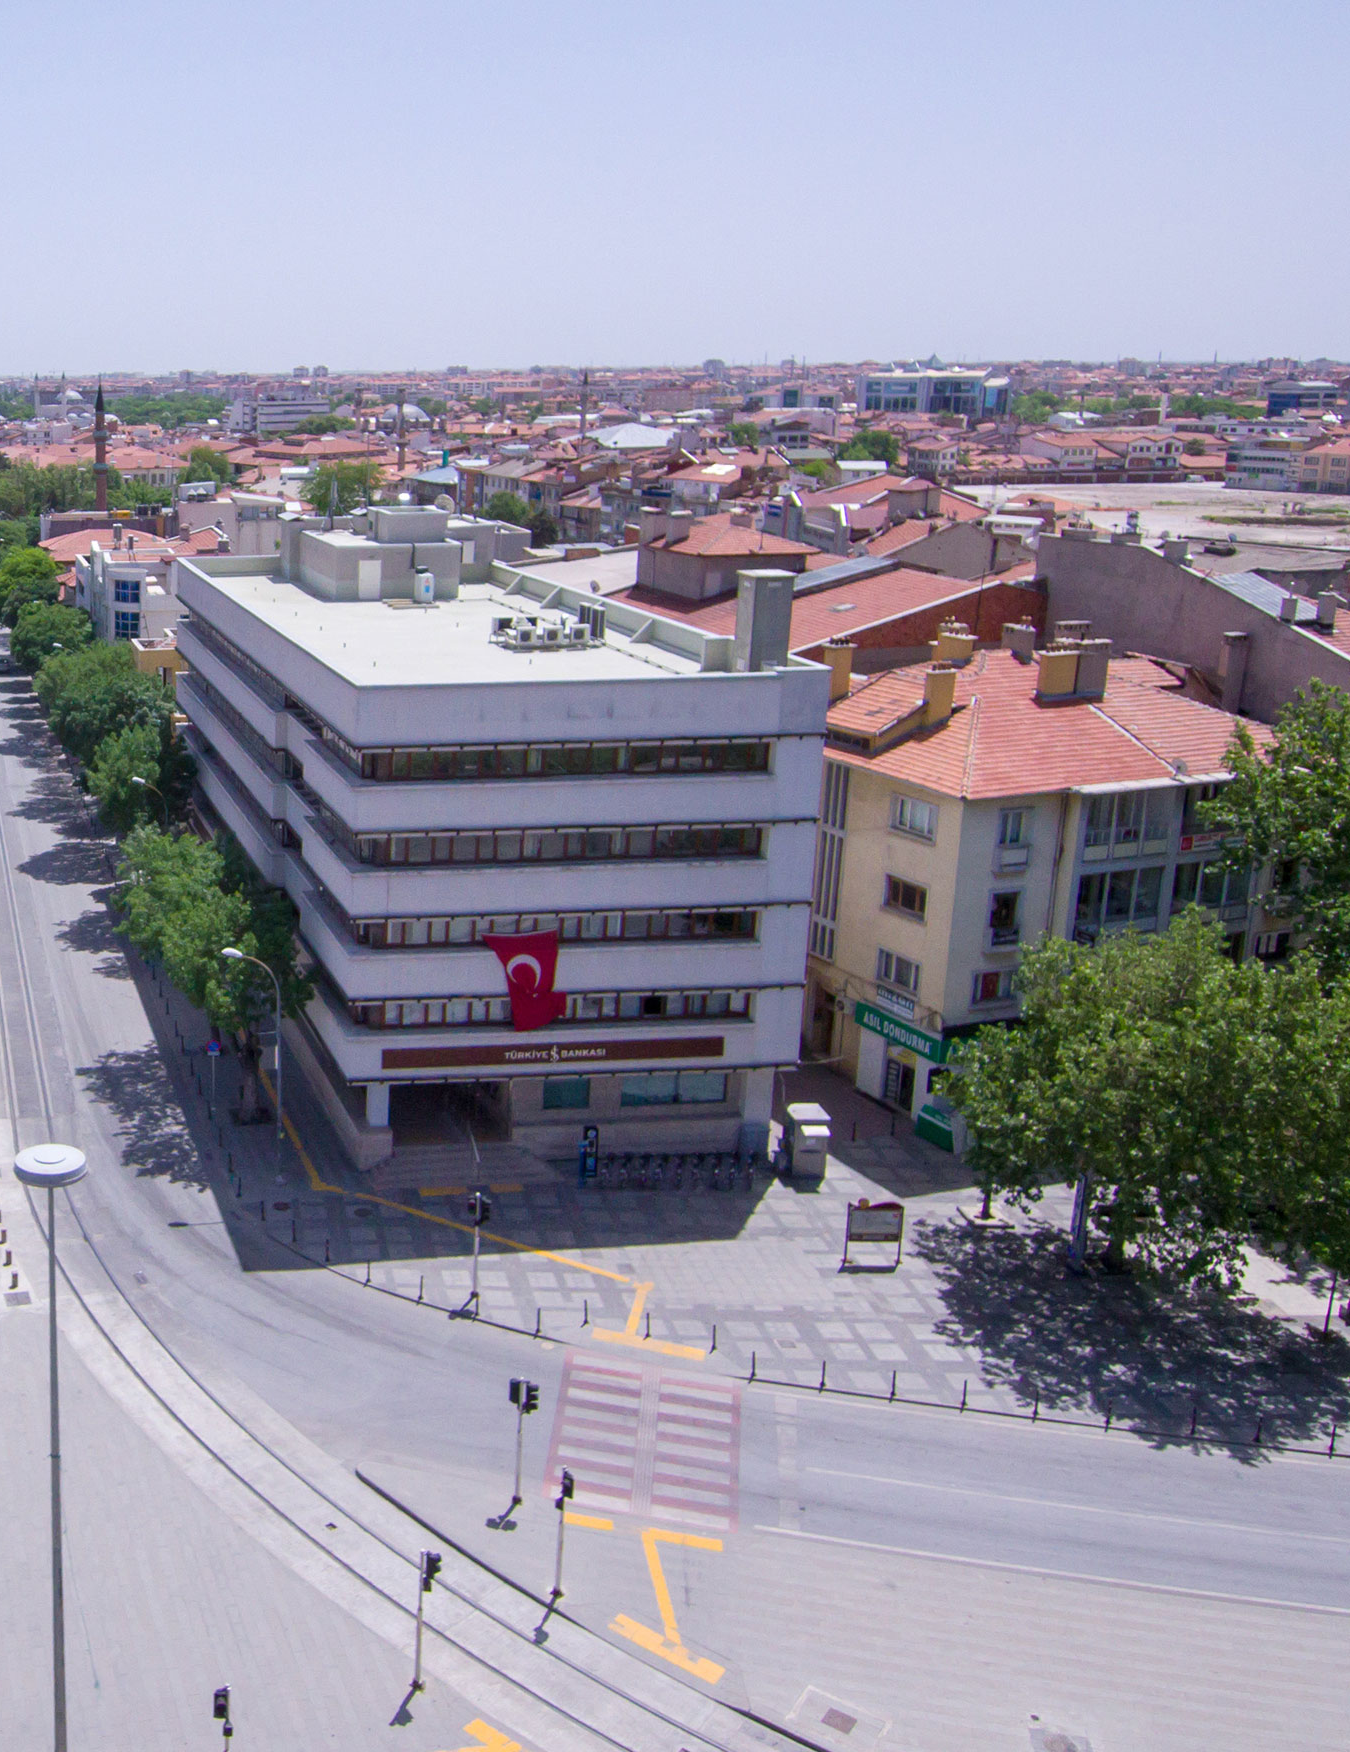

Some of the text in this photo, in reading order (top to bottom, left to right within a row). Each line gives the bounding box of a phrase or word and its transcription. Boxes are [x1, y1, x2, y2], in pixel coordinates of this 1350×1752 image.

[883, 1020, 930, 1055] DONDURMA
[504, 1050, 549, 1060] TÜRKİYE
[561, 1048, 606, 1058] BANKASI
